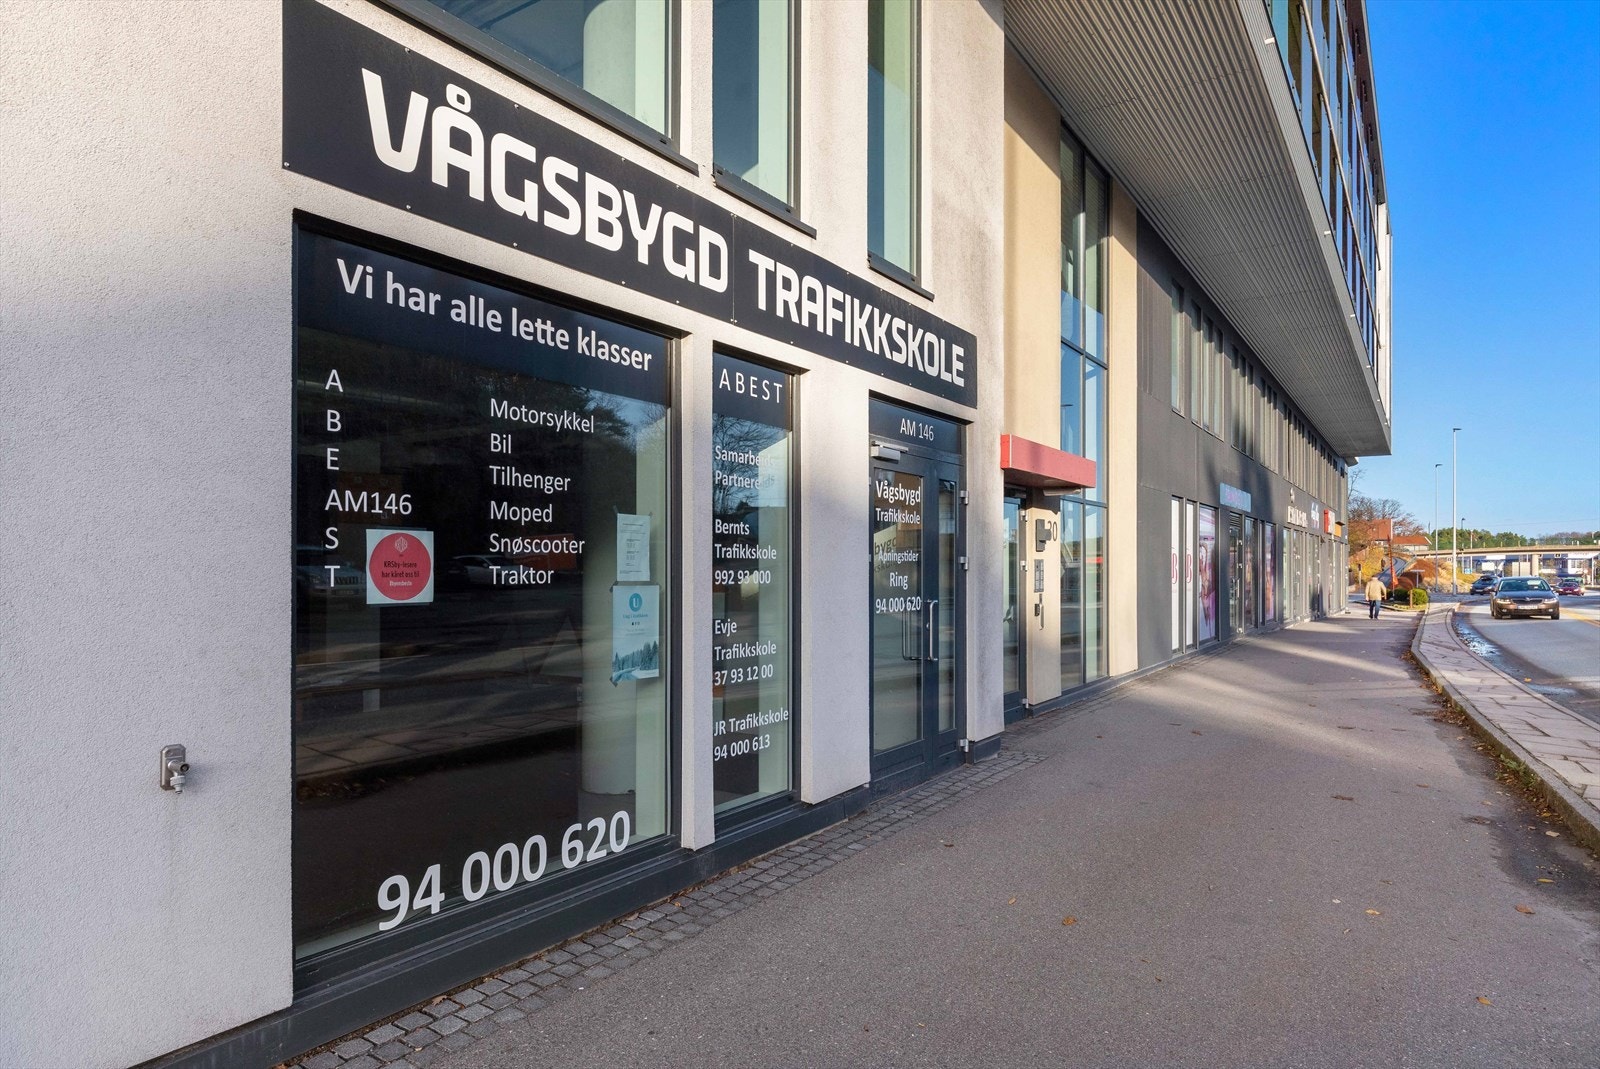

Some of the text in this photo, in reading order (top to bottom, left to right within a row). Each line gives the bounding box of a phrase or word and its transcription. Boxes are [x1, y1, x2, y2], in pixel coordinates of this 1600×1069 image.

[361, 67, 965, 388] VÅGSBYGD TRAFIKKSKOLE
[336, 258, 652, 371] Vi har alle lette klasser
[325, 369, 343, 392] A
[327, 409, 342, 432] B
[490, 398, 594, 433] Motorsykkel
[900, 418, 934, 441] AM 146
[490, 433, 512, 454] Bil
[326, 448, 340, 471] E
[489, 465, 571, 494] Tilhenger
[324, 489, 412, 515] AM146
[875, 480, 921, 506] Vågsbygd
[490, 500, 553, 526] Moped
[875, 508, 920, 524] Trafikkskole
[325, 526, 339, 549] S
[714, 518, 750, 535] Bernts
[489, 533, 585, 554] Snøscooter
[714, 543, 777, 560] Trafikkskole
[324, 565, 340, 588] T
[489, 564, 554, 585] Traktor
[714, 570, 771, 585] 992 93 000
[889, 571, 909, 590] Ring
[875, 596, 921, 613] 94 000 620
[714, 618, 738, 637] Evje
[714, 640, 777, 661] Trafikkskole
[714, 664, 774, 686] 37 93 12 00
[713, 707, 789, 736] JR Trafikkskole
[714, 734, 771, 761] 94 000 613
[377, 810, 631, 931] 94 000 620
